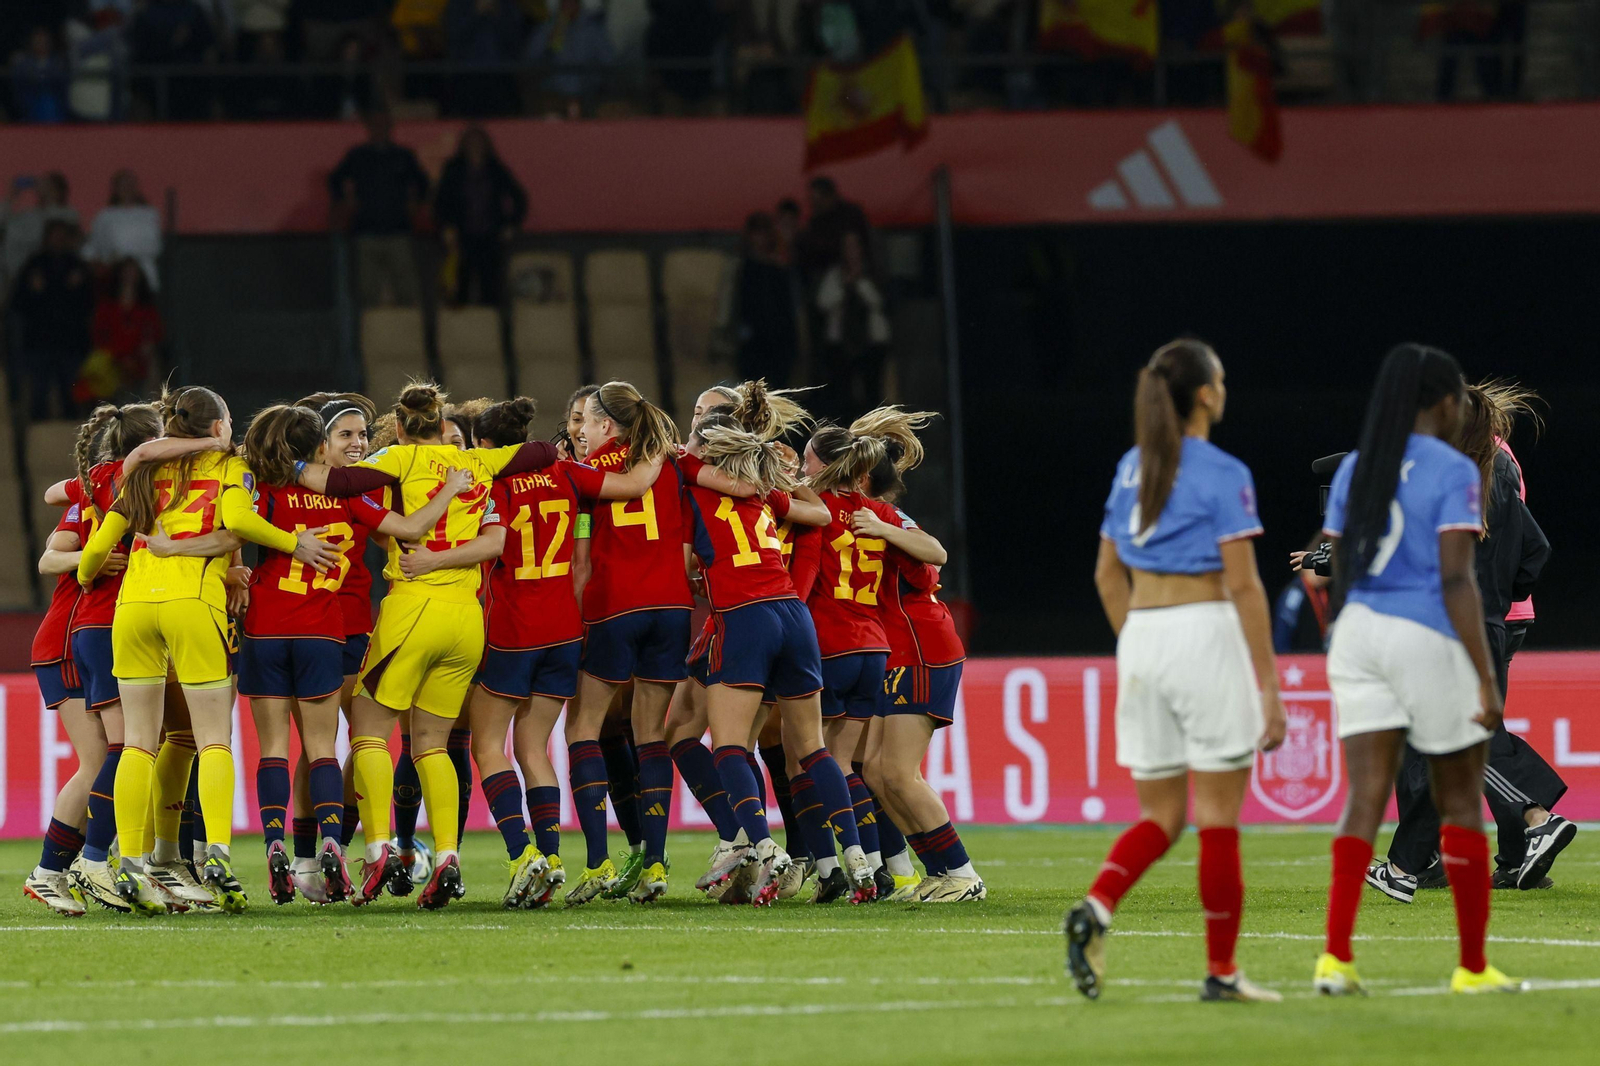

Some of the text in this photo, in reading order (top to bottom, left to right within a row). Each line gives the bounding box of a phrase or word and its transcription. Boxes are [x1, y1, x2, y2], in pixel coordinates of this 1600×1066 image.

[590, 447, 629, 469] PARE
[509, 498, 571, 580] 12
[611, 486, 659, 541] 4
[830, 529, 887, 606] 15
